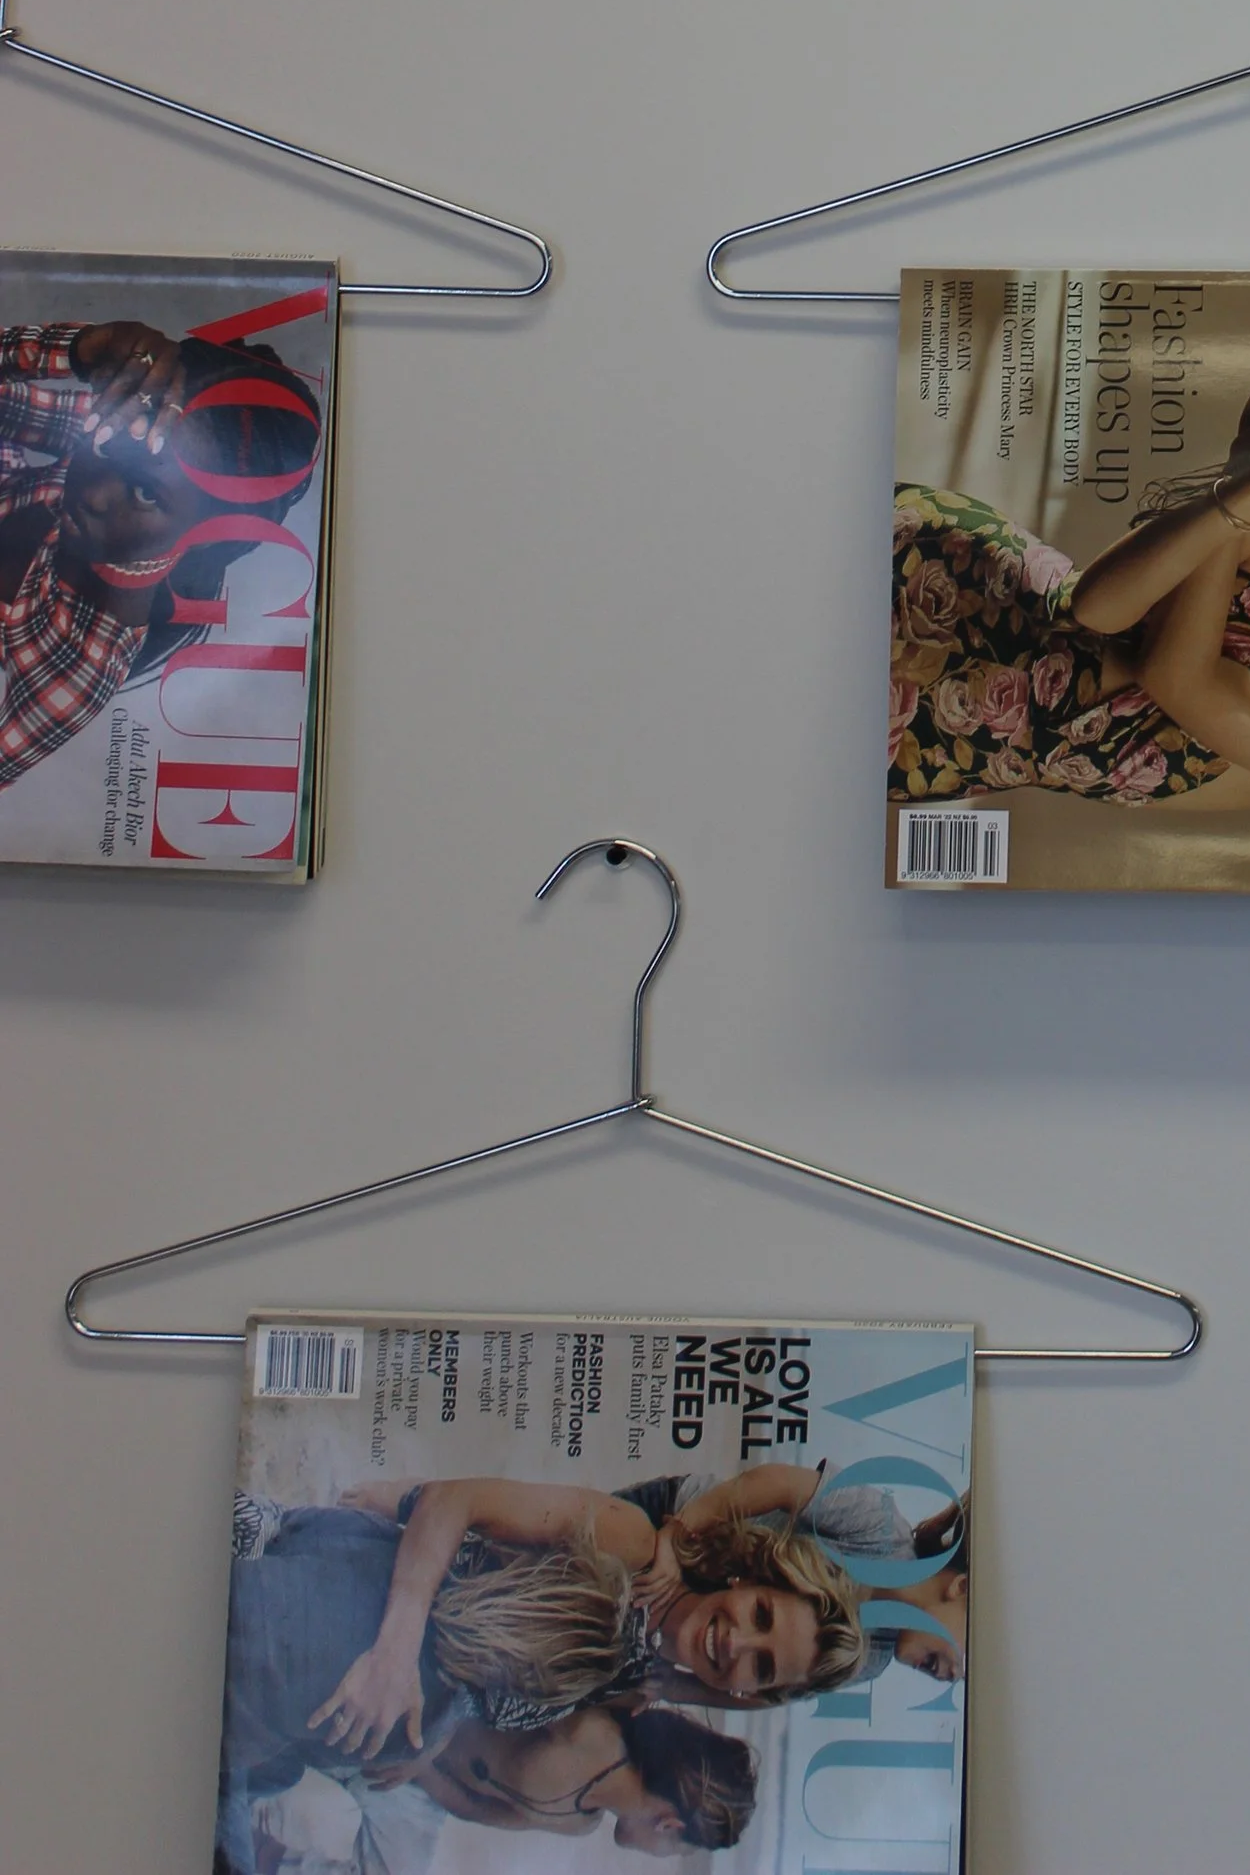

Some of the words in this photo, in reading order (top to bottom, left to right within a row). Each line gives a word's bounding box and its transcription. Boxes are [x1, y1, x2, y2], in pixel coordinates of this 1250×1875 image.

[923, 279, 935, 317] meets
[940, 279, 956, 318] When
[958, 280, 974, 328] BRAIN
[1004, 281, 1019, 315] HRH
[1022, 281, 1037, 314] THE
[1067, 281, 1083, 334] STYLE
[920, 320, 935, 401] mindfulness
[957, 331, 973, 372] GAIN
[1002, 318, 1018, 362] Crown
[1020, 317, 1036, 373] NORTH
[1065, 338, 1081, 373] FOR
[1086, 282, 1150, 432] shapes
[934, 321, 953, 420] neuroplasticity
[1001, 365, 1016, 421] Princess
[1151, 284, 1204, 455] Fashion
[1019, 376, 1034, 416] STAR
[1064, 377, 1081, 435] EVERY
[997, 424, 1015, 461] Mary
[1063, 438, 1080, 487] BODY
[1083, 446, 1130, 503] up
[150, 272, 329, 861] VOGUE
[104, 708, 128, 787] Challenging
[130, 720, 150, 758] Adut
[106, 789, 123, 809] for
[126, 761, 148, 808] Akech
[99, 810, 121, 857] change
[123, 813, 145, 846] Bior
[428, 1329, 443, 1377] ONLY
[483, 1331, 499, 1364] their
[499, 1331, 514, 1373] punch
[517, 1332, 534, 1399] Workouts
[630, 1334, 647, 1368] puts
[651, 1336, 669, 1369] Elsa
[708, 1338, 741, 1405] WE
[744, 1337, 776, 1375] IS
[441, 1330, 460, 1422] MEMBERS
[478, 1367, 494, 1413] weight
[497, 1377, 513, 1417] above
[568, 1333, 587, 1458] PREDICTIONS
[587, 1333, 604, 1414] FASHION
[672, 1335, 706, 1449] NEED
[777, 1338, 811, 1444] LOVE
[515, 1403, 530, 1430] that
[626, 1373, 647, 1423] family
[646, 1375, 668, 1428] Pataky
[741, 1384, 774, 1460] ALL
[628, 1427, 645, 1461] first
